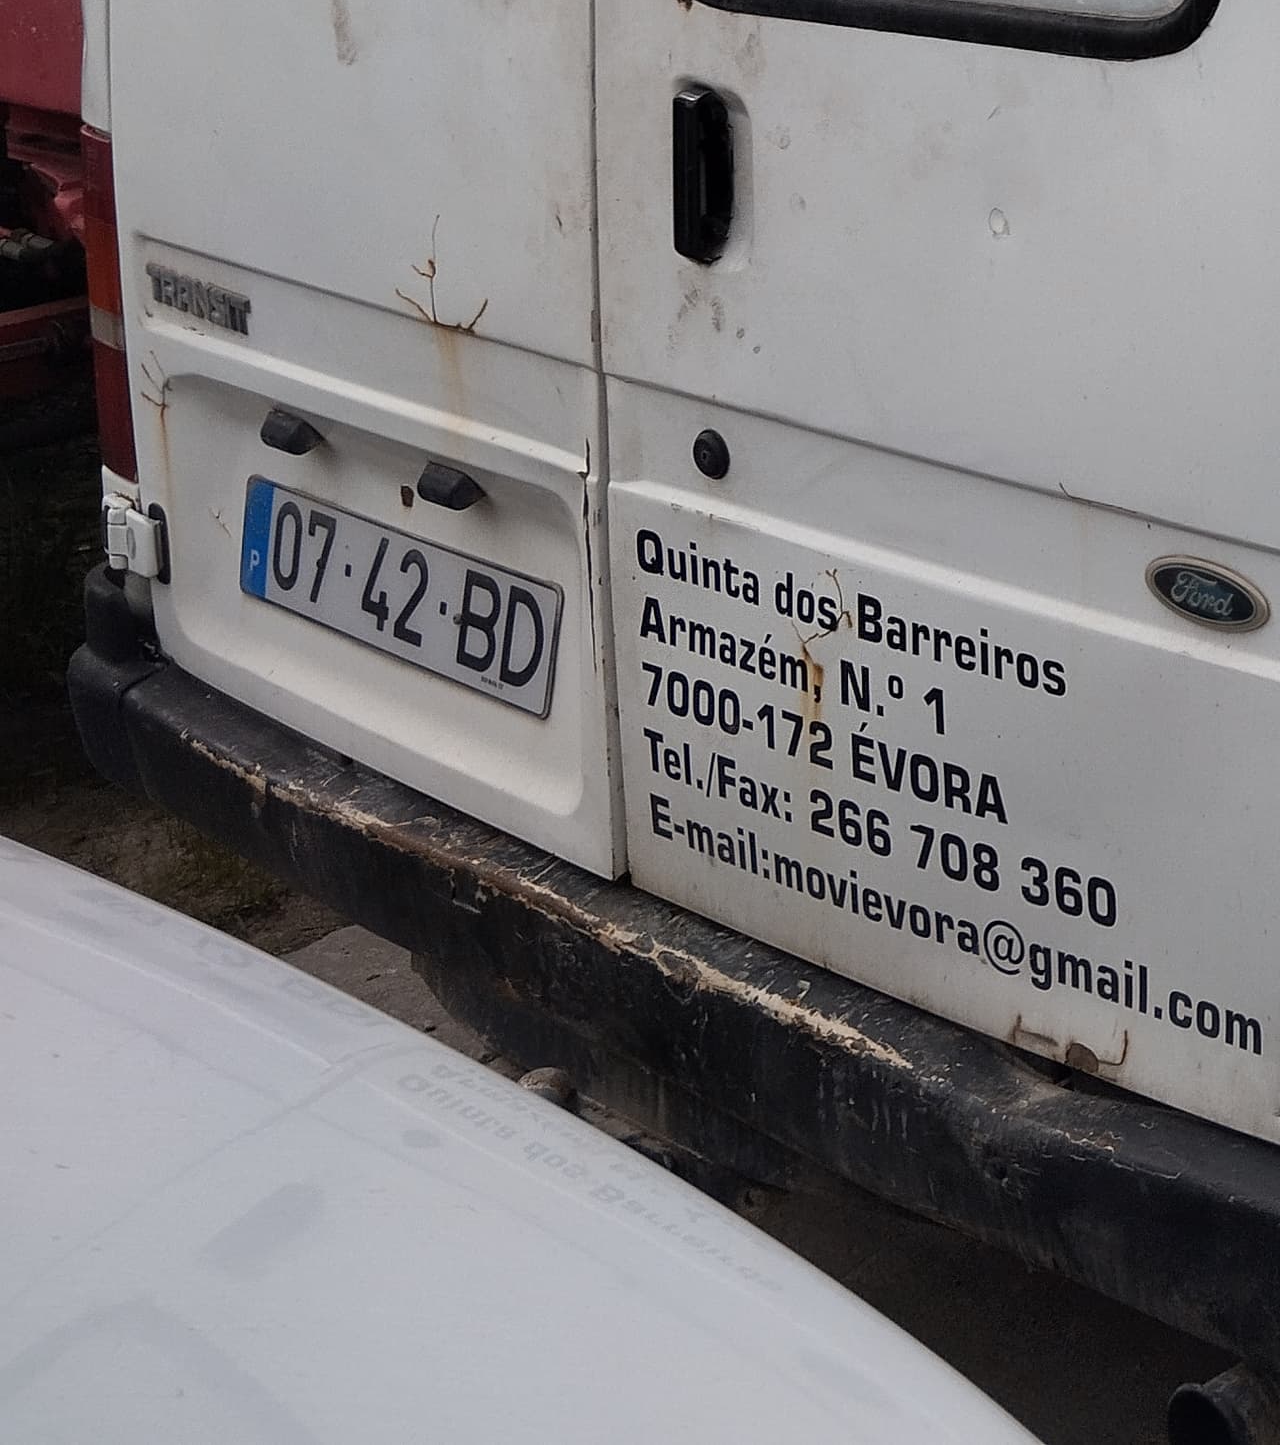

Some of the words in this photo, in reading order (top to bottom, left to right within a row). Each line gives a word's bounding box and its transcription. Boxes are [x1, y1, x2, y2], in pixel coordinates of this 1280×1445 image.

[145, 262, 252, 336] TRANSIT
[249, 549, 261, 572] P
[634, 528, 761, 606] Quinta
[774, 571, 840, 633] dos
[856, 592, 1068, 699] Barreiros
[1170, 570, 1236, 617] Ford
[639, 595, 824, 705] Armazém,
[923, 687, 946, 736] 1
[641, 660, 834, 771] 7000-172
[850, 722, 1009, 825] ÉVORA
[642, 726, 794, 824] Tel./Fax:
[809, 789, 893, 858] 266
[910, 823, 1001, 895] 708
[1020, 855, 1117, 928] 360
[648, 792, 1264, 1056] E-mail:movievora@gmail.com
